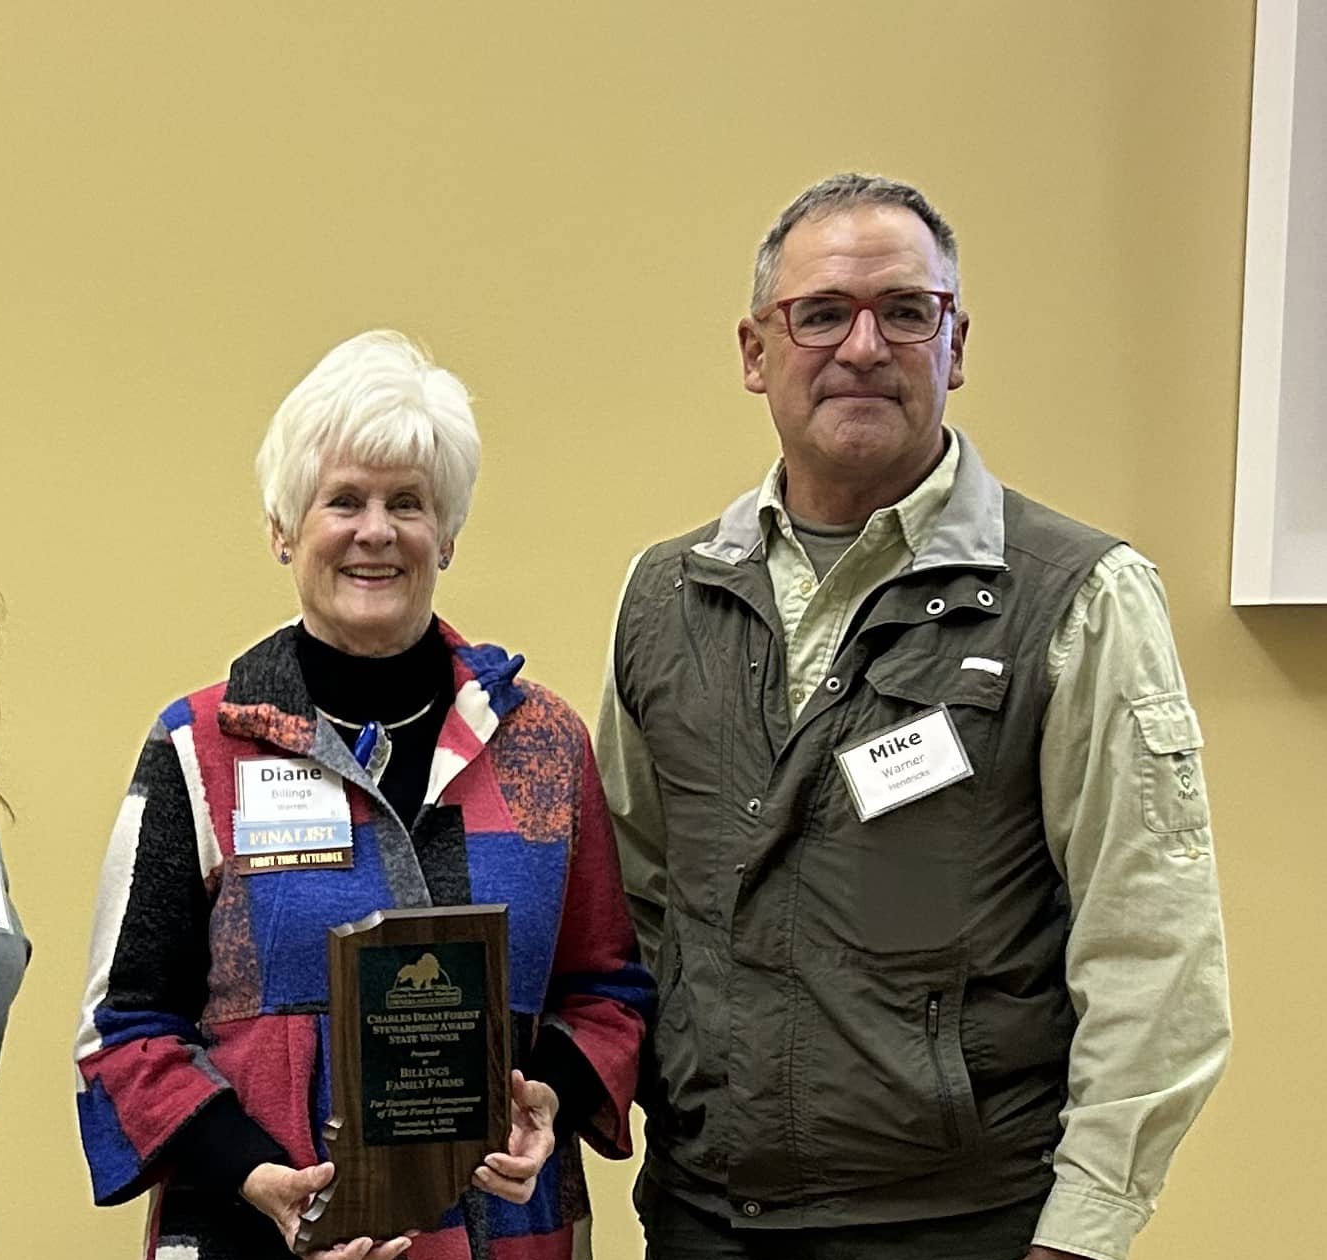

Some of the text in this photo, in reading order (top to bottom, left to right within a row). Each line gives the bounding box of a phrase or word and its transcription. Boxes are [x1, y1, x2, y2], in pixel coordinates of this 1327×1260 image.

[869, 732, 923, 763] Mike
[881, 753, 925, 778] Warner
[261, 767, 323, 782] Diane
[271, 788, 313, 800] Billings
[249, 826, 335, 846] FINALIST
[250, 855, 275, 868] FIRST
[276, 854, 299, 866] TIME
[367, 1014, 412, 1025] CHARLES
[440, 1021, 476, 1032] AWARD
[388, 1035, 419, 1045] STATE
[400, 1067, 450, 1078] BILLINGS
[385, 1078, 465, 1091] FAMILY FARMS
